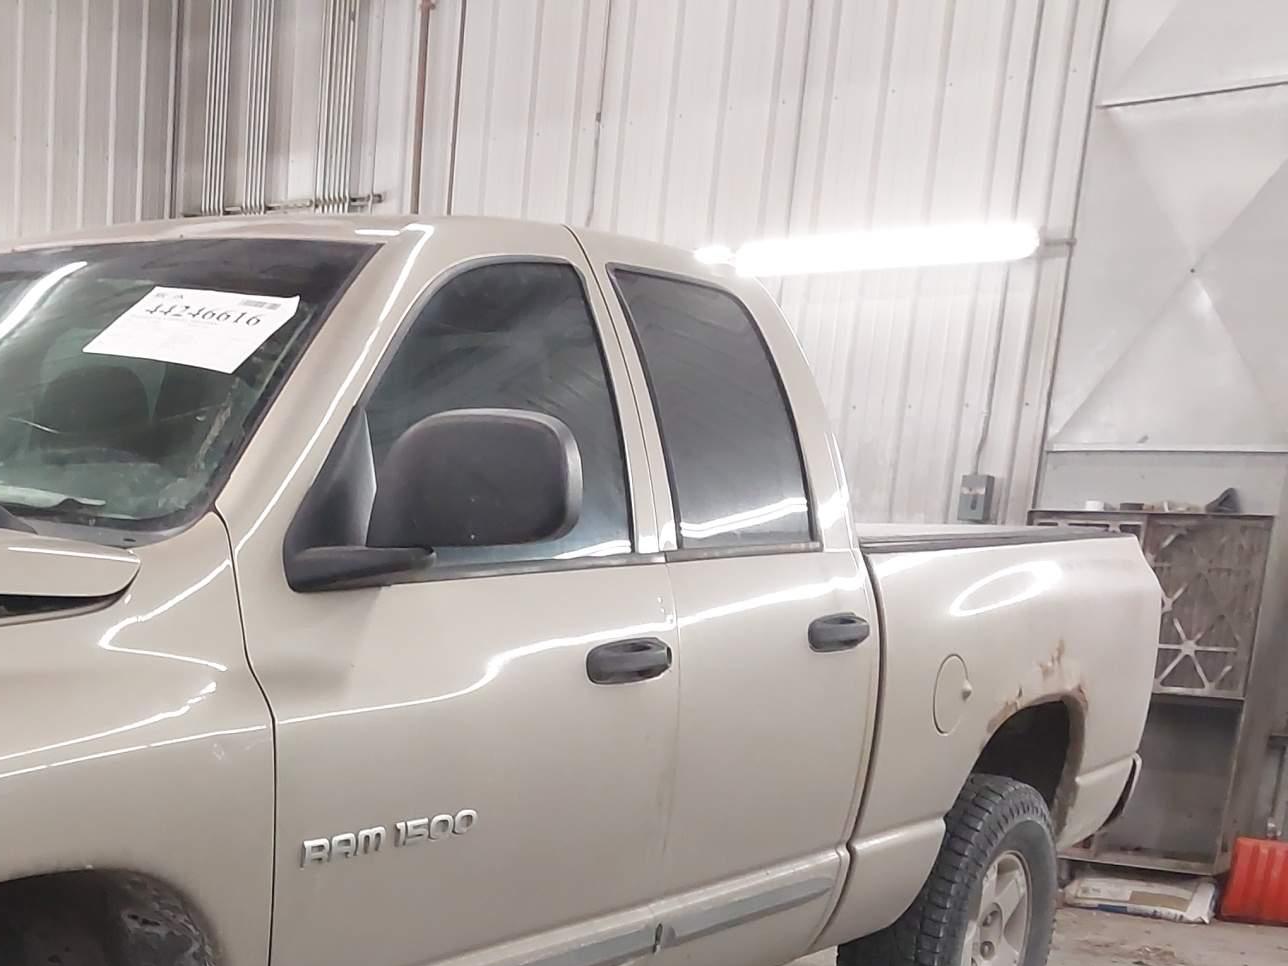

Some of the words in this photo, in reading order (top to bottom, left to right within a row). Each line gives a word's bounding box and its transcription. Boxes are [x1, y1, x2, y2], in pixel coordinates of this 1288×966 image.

[144, 302, 262, 327] 44246616
[300, 826, 386, 868] RAM
[394, 809, 478, 847] 1500
